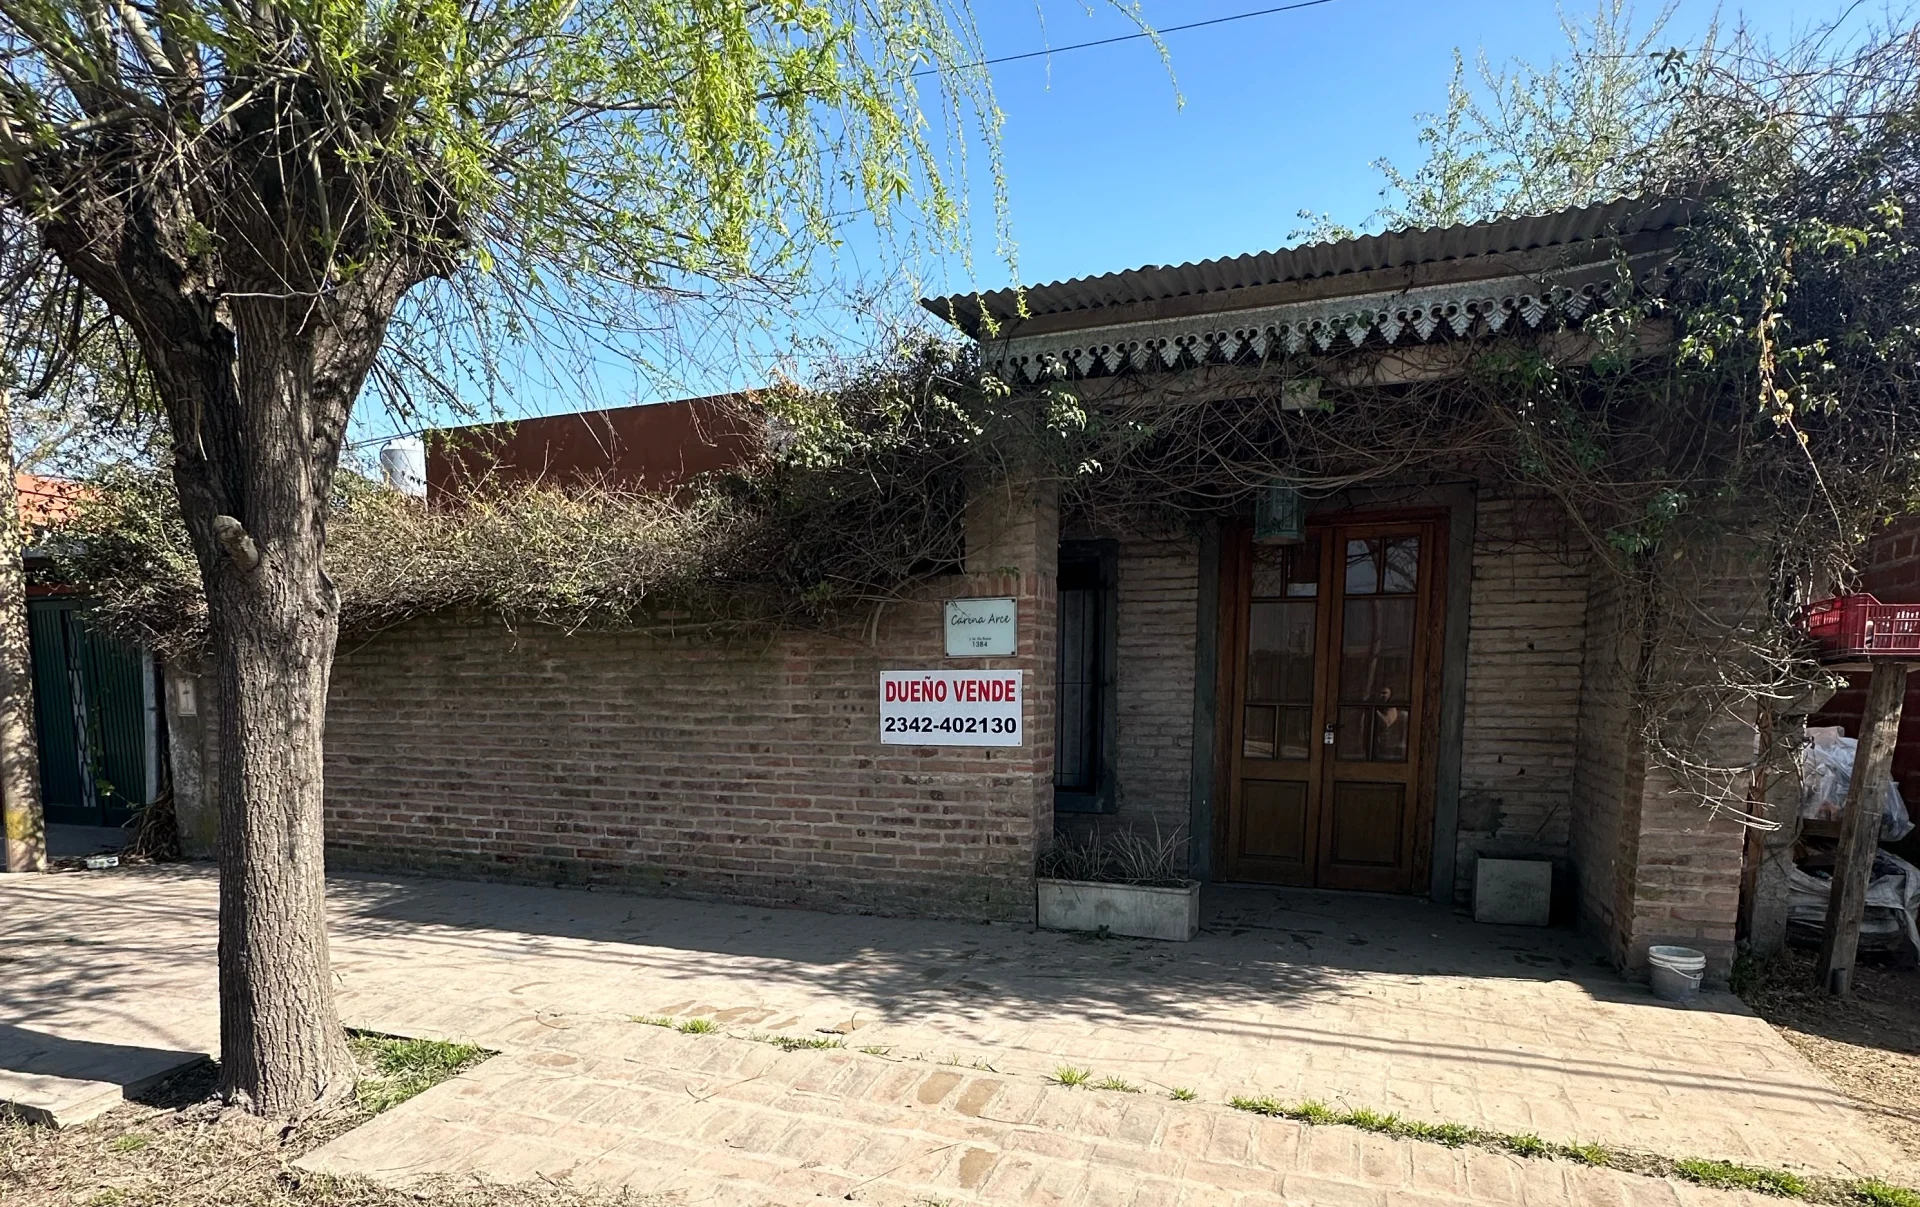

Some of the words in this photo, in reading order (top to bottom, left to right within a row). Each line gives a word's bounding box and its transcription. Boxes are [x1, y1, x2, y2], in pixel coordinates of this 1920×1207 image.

[951, 614, 985, 626] Carina
[988, 613, 1011, 624] Arce
[885, 675, 947, 702] DUEÑO
[953, 680, 1016, 702] VENDE
[884, 717, 1017, 733] 2342-402130
